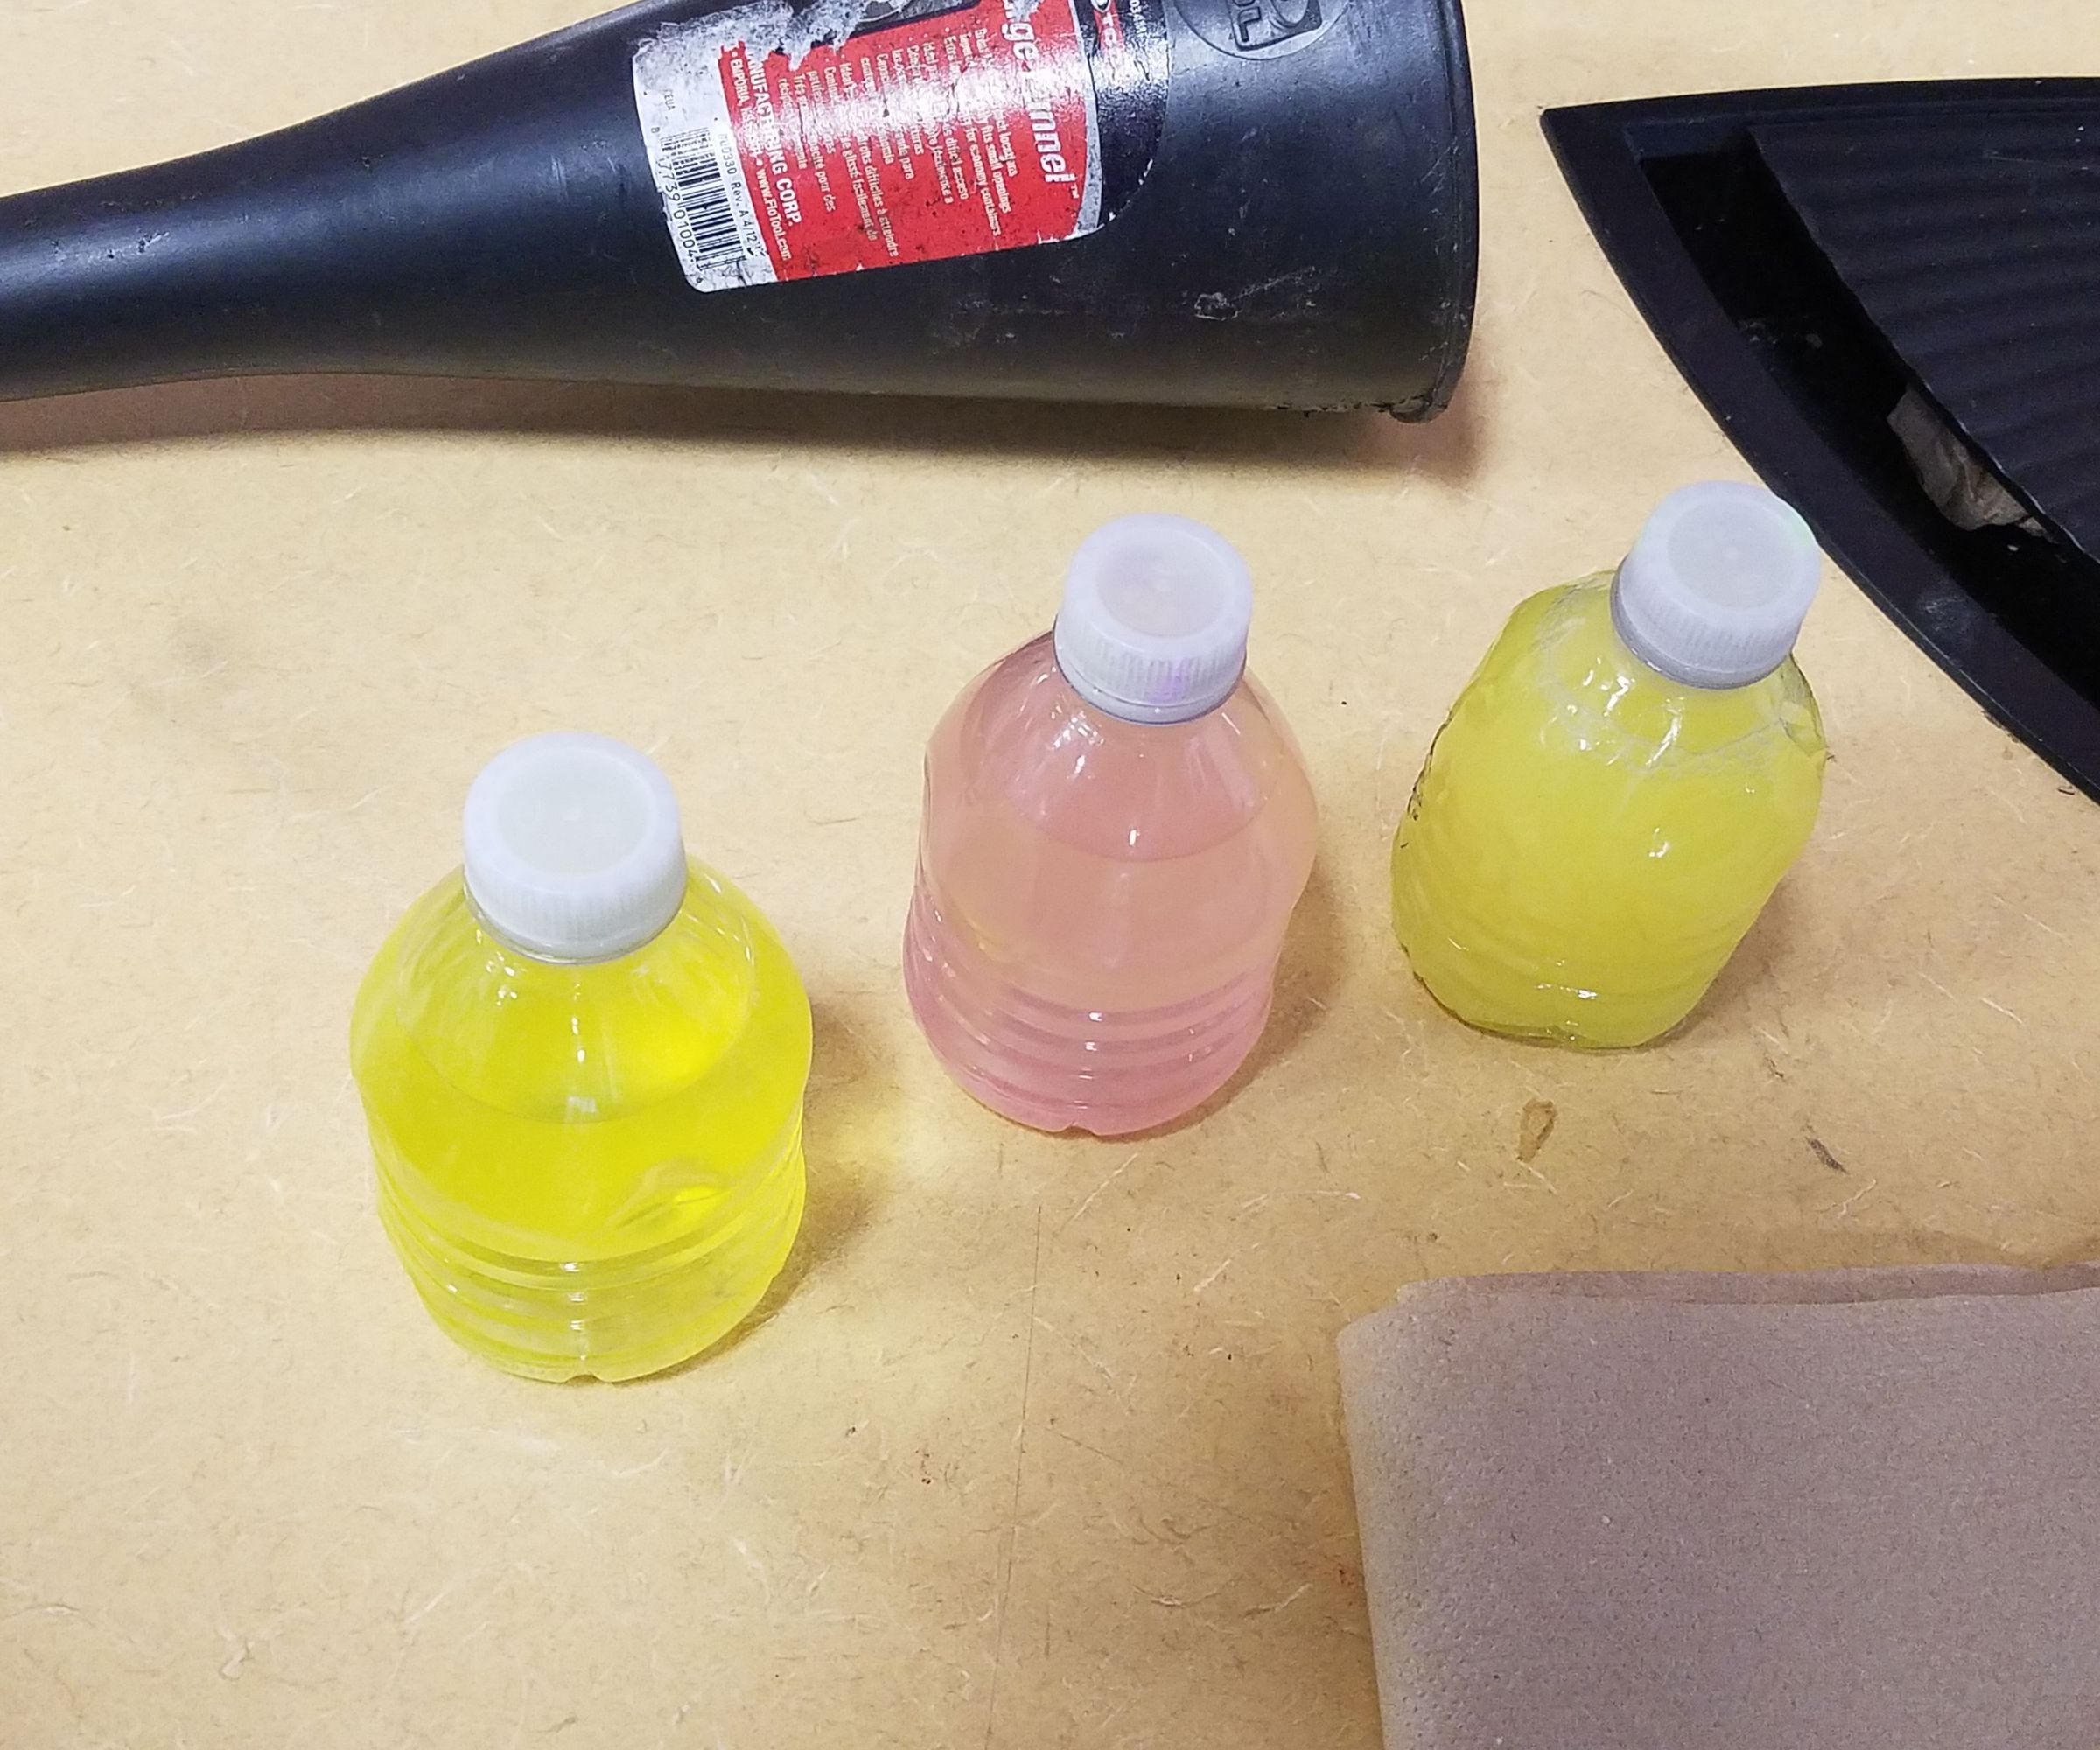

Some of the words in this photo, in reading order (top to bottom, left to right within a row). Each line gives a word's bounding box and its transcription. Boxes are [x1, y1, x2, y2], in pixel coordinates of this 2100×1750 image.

[730, 181, 746, 206] Rev.
[738, 208, 748, 217] A
[776, 177, 801, 226] CORP.
